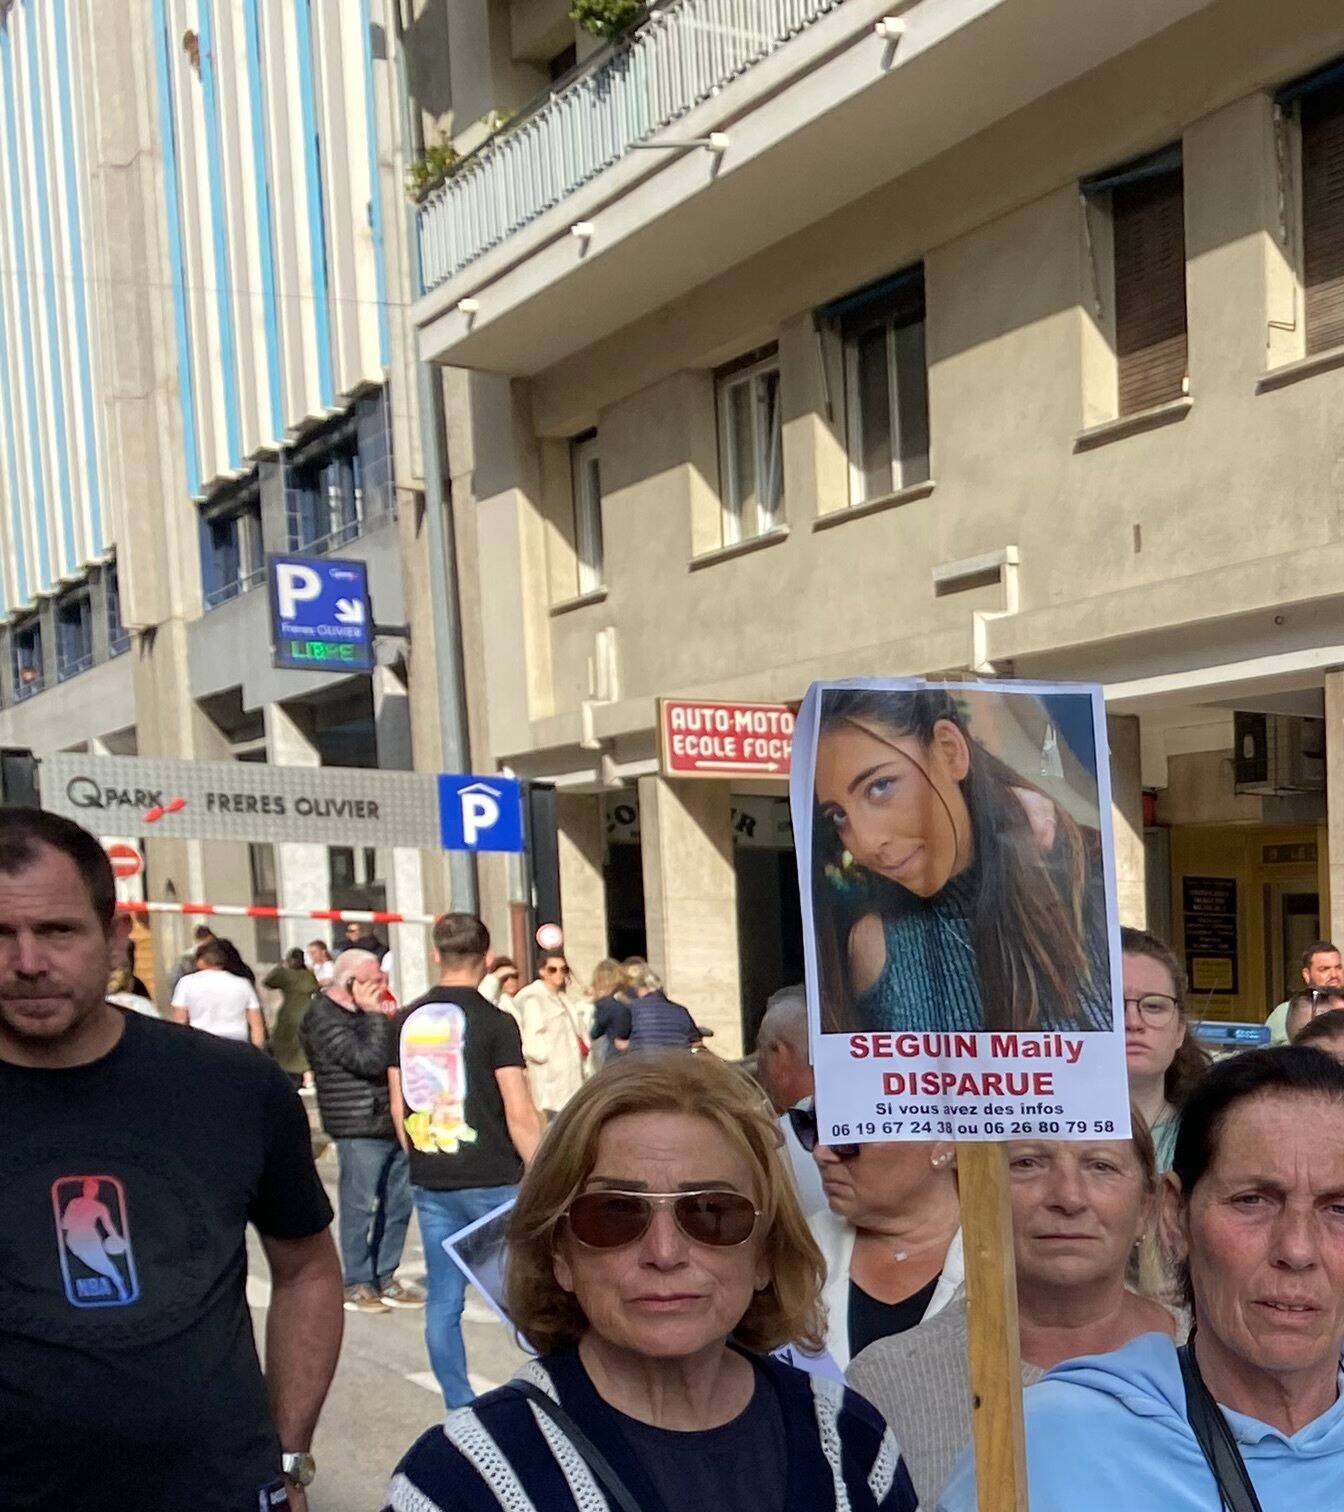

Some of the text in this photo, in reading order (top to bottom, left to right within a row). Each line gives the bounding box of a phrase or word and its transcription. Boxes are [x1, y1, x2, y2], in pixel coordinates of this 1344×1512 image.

[276, 563, 322, 619] P
[673, 735, 793, 759] ECOLE FOCH
[206, 792, 286, 816] FRERES
[294, 796, 380, 821] OLIVIER
[463, 793, 499, 846] P
[850, 1034, 1084, 1063] SEGUIN Maily
[882, 1072, 1054, 1095] DISPARUE
[875, 1102, 1064, 1115] Si vous avez des infos
[832, 1120, 1114, 1136] 06 19 67 24 38 ou 06 26 80 79 58
